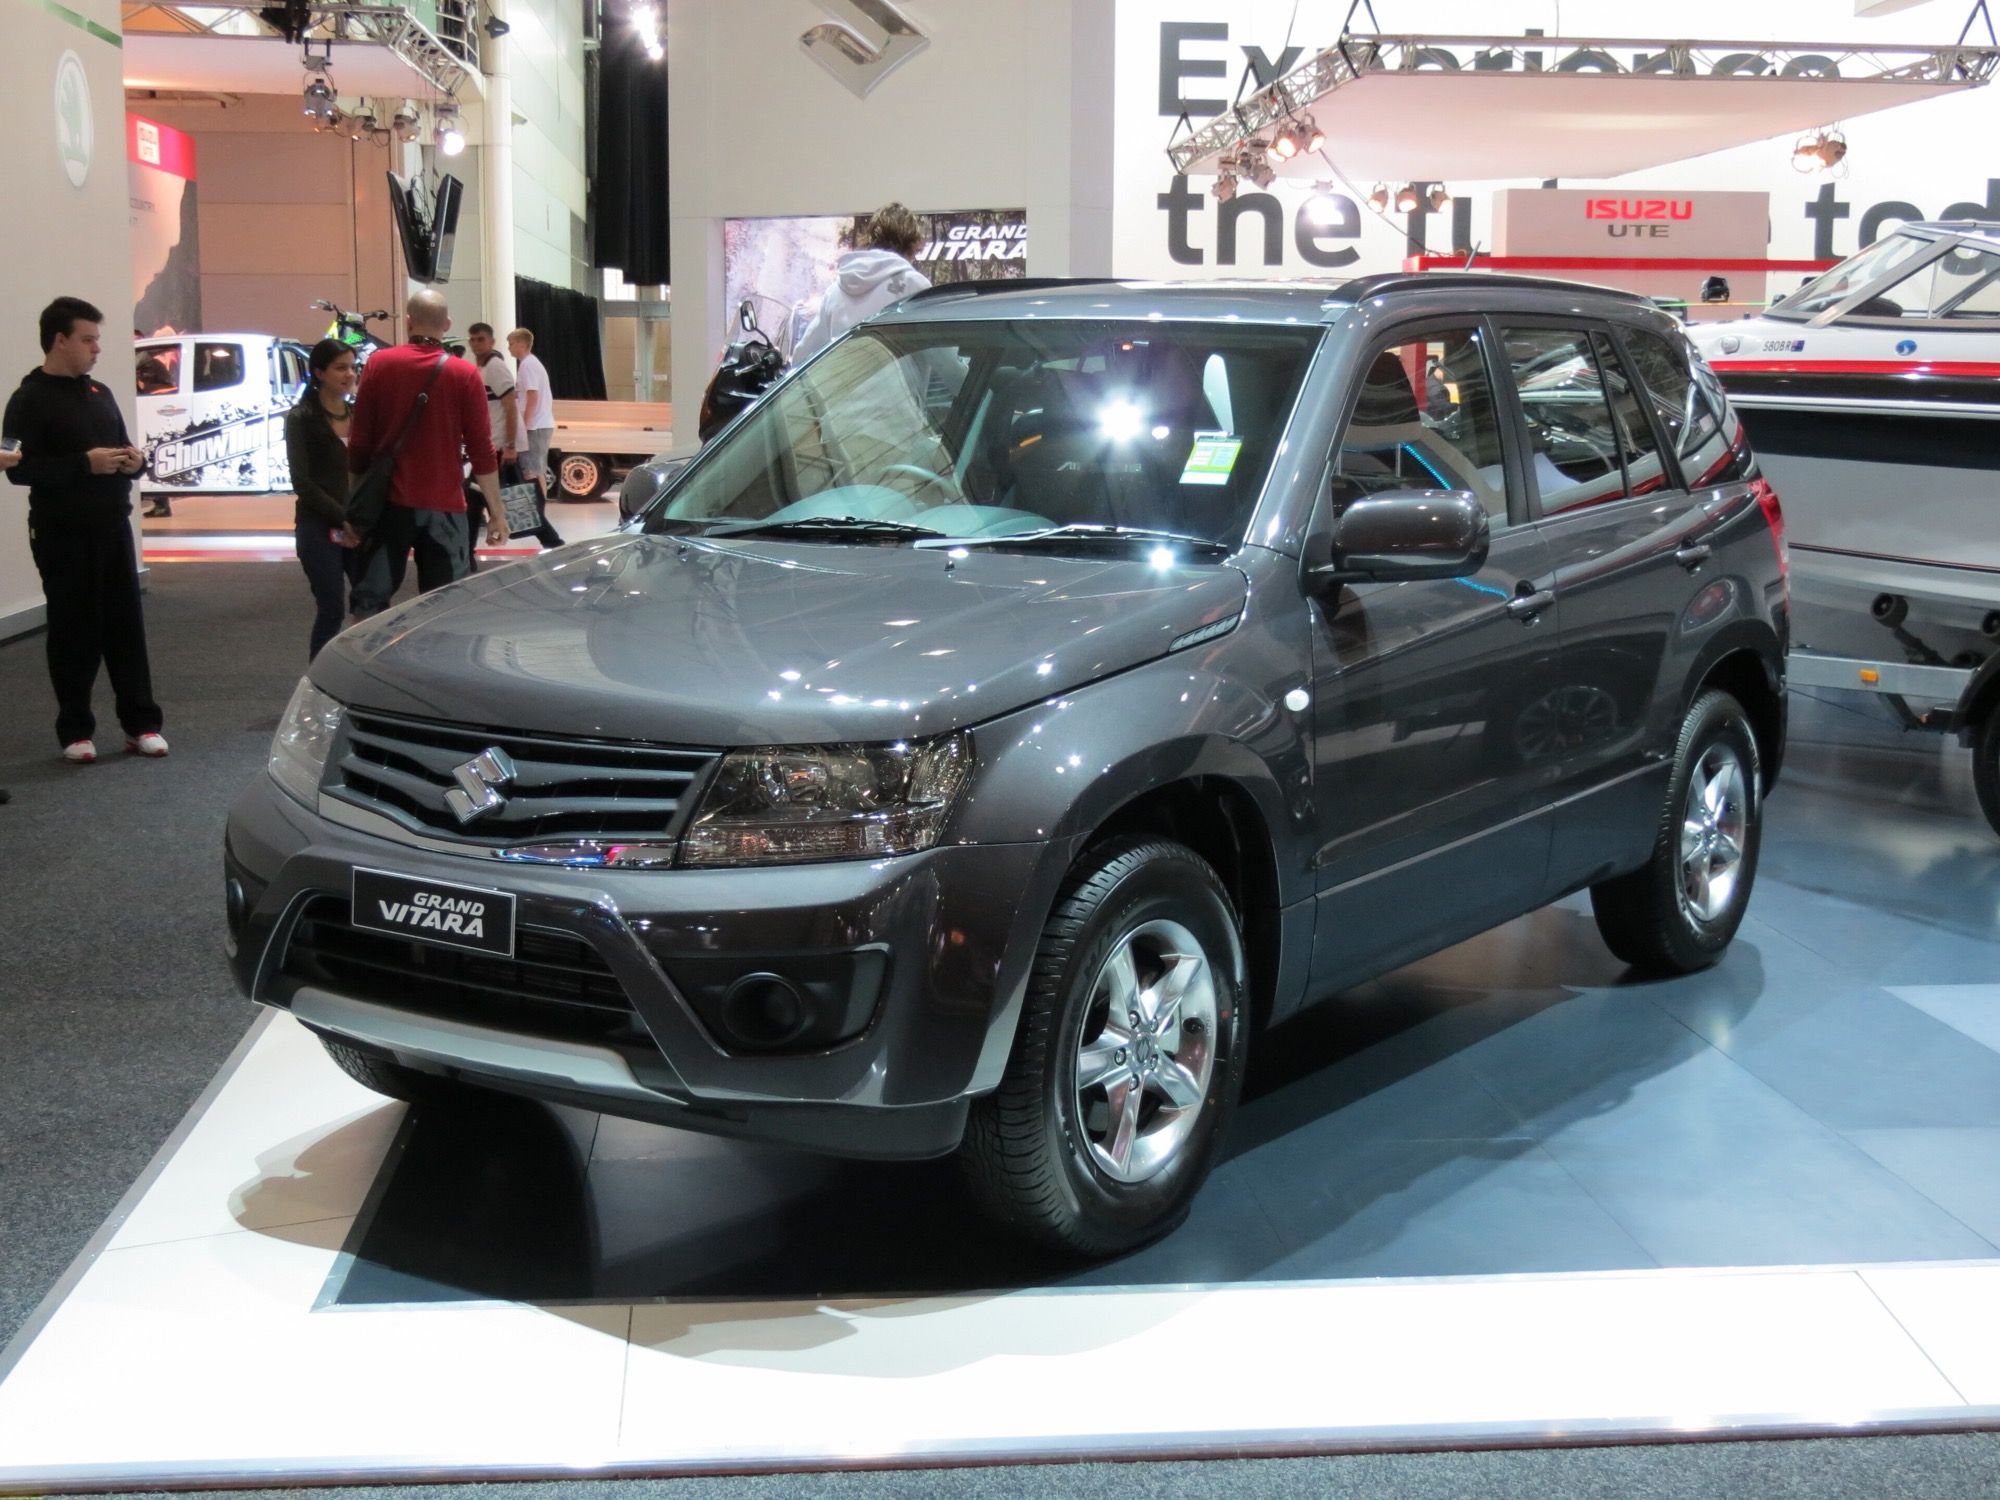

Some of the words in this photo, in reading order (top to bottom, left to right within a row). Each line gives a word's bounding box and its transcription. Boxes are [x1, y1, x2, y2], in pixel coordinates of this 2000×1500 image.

[1157, 174, 1361, 268] the
[1586, 199, 1693, 221] ISUZU
[948, 225, 1026, 240] GRAND
[1607, 224, 1670, 238] UTE
[413, 892, 485, 916] GRAND
[379, 900, 484, 938] VITARA
